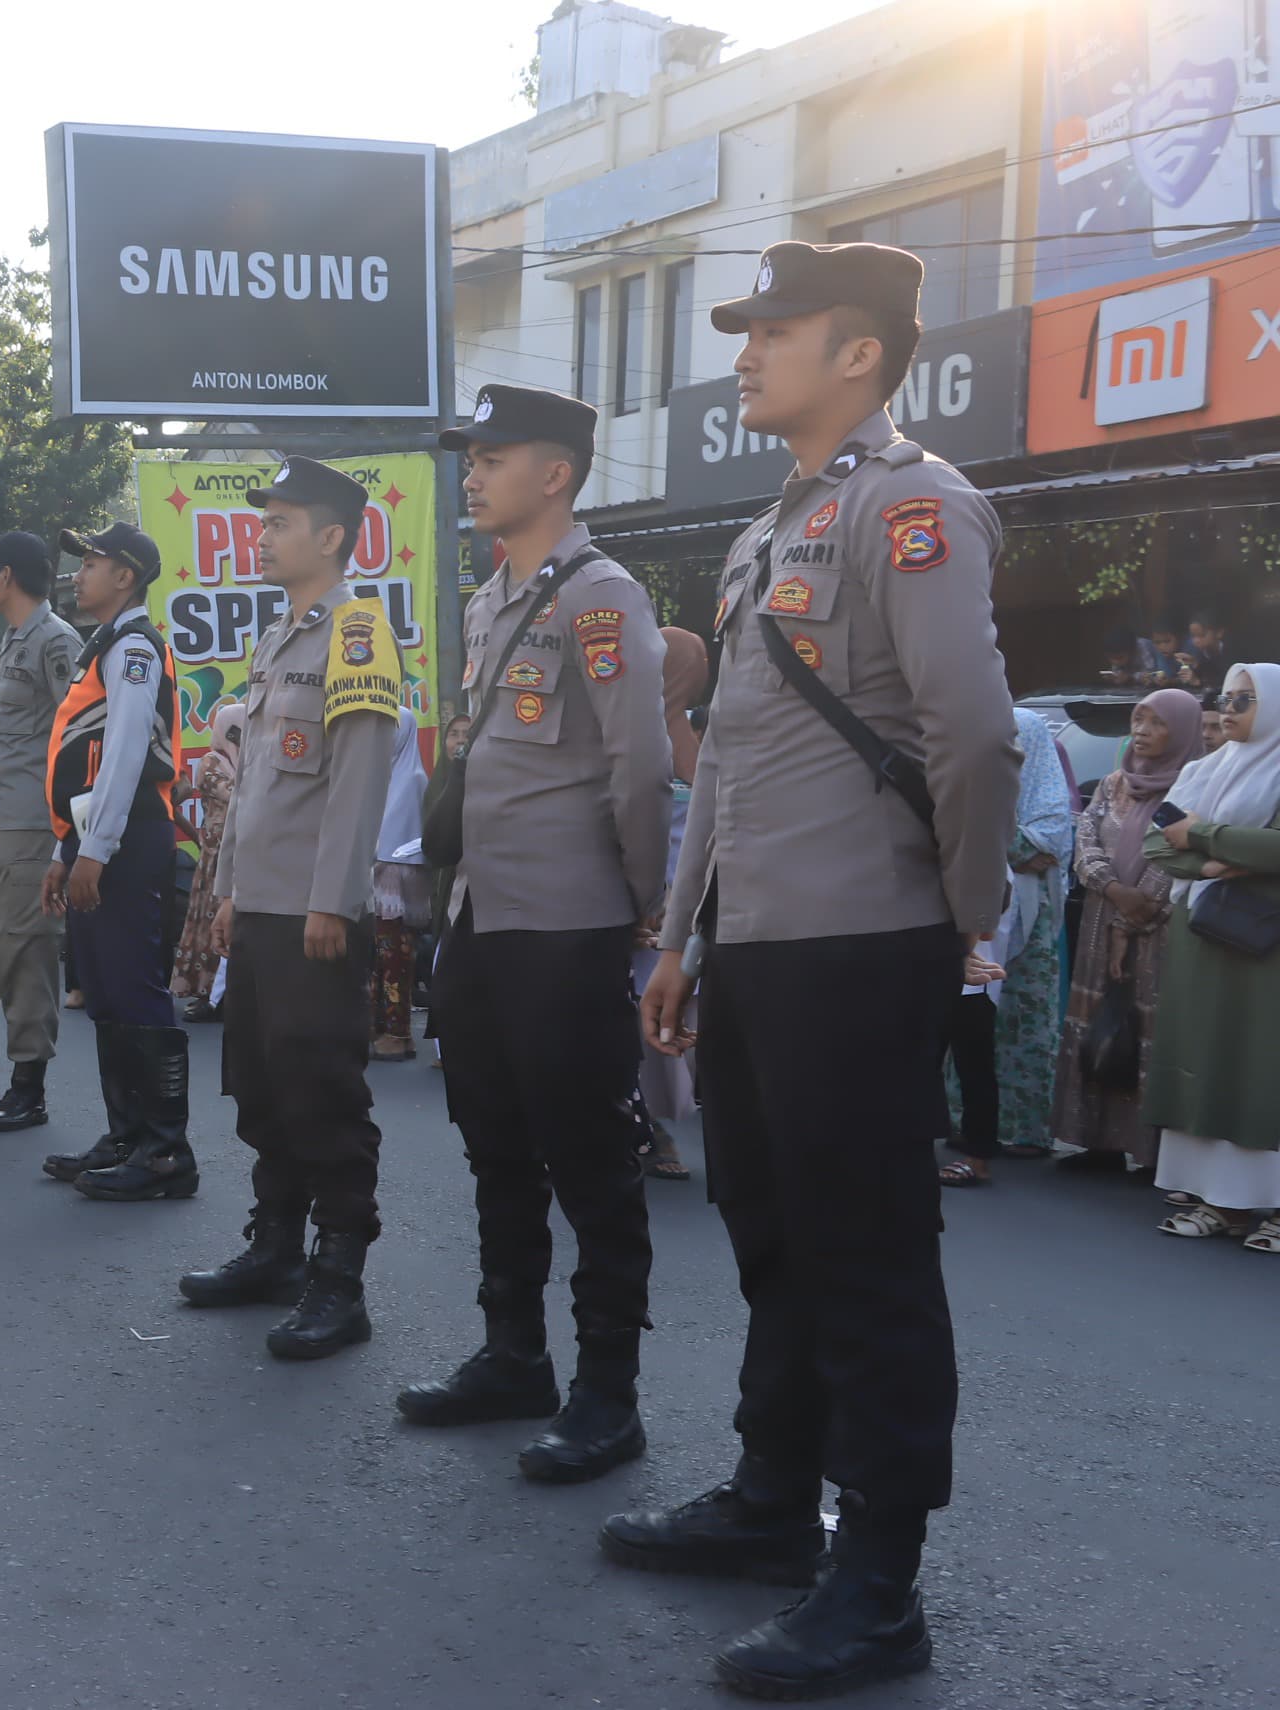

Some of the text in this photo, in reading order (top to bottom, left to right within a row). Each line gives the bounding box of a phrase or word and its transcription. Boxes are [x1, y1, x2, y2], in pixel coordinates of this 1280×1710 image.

[119, 245, 390, 302] SAMSUNG
[192, 371, 329, 391] ANTON LOMBOK
[701, 353, 973, 464] SANG
[194, 474, 261, 491] ANTON
[196, 505, 388, 581] PRO
[781, 543, 835, 566] POLRI
[576, 610, 620, 626] POLRES
[520, 631, 562, 652] OLRI
